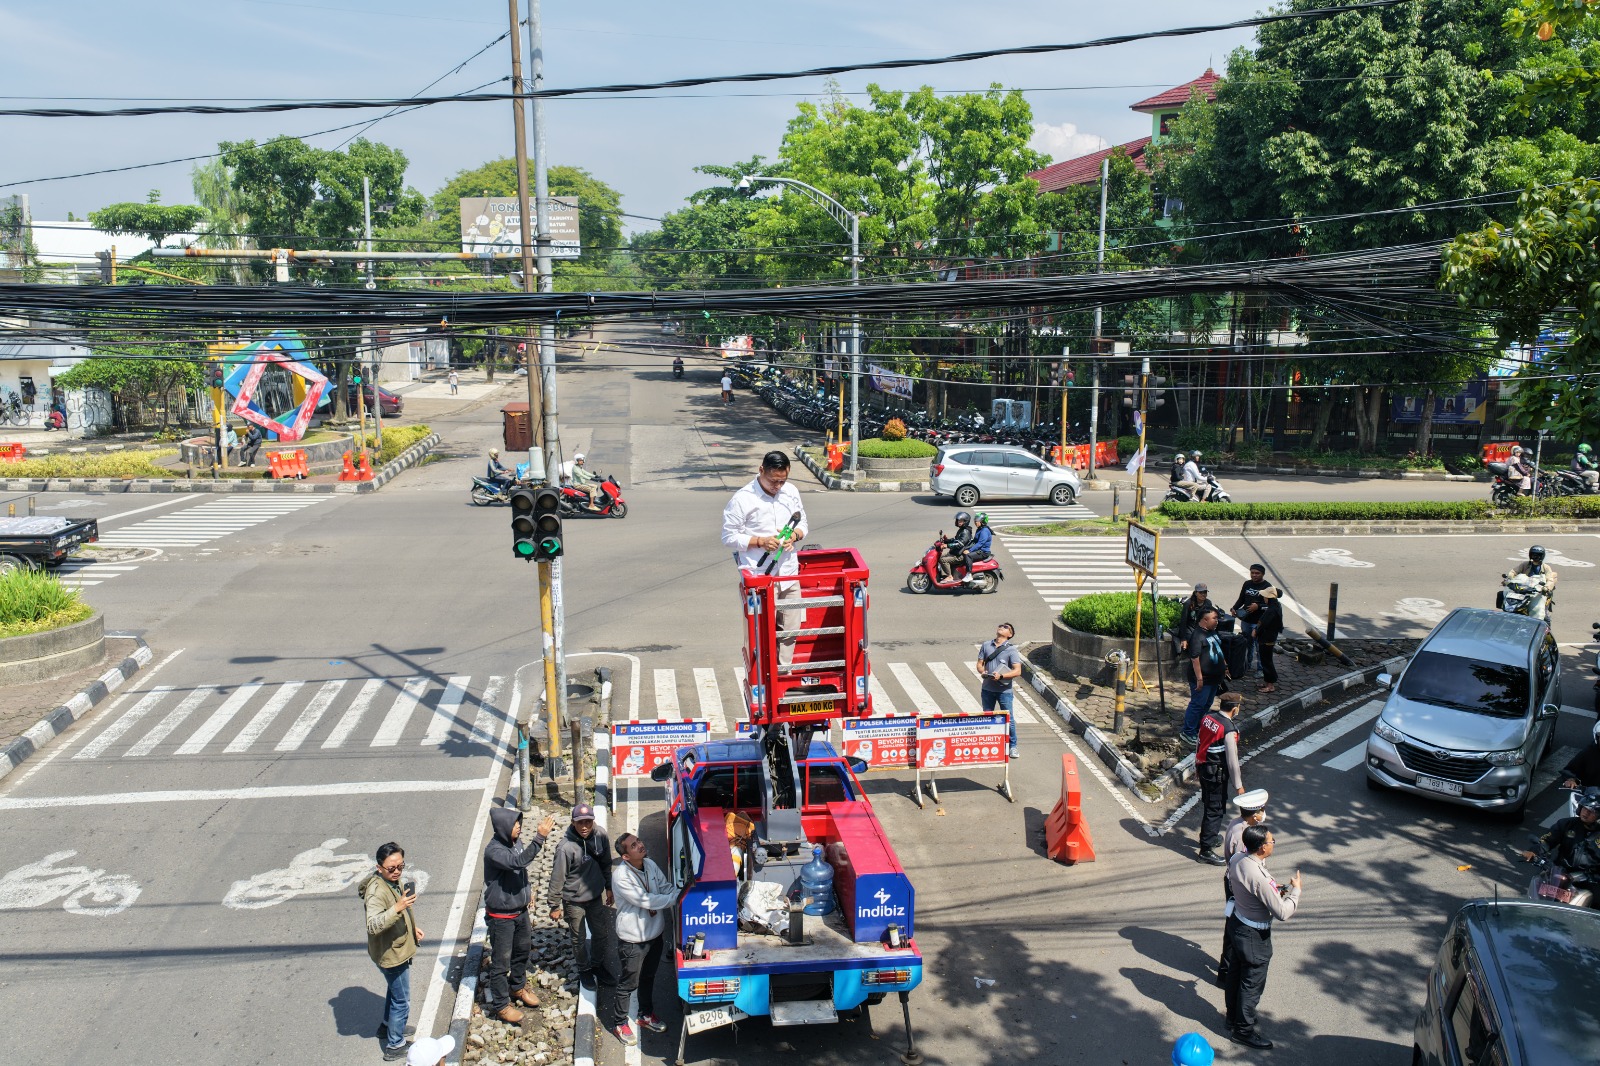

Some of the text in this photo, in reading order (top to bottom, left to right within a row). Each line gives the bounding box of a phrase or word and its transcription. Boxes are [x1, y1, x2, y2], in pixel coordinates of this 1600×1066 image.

[791, 701, 832, 713] MAX. 100 KG
[657, 724, 693, 732] LENGKONG
[933, 718, 957, 726] POLSEK
[1202, 716, 1220, 734] POLISI
[878, 738, 904, 746] BEYOND
[951, 736, 978, 744] BEYOND
[858, 904, 905, 918] indibiz
[685, 912, 734, 926] indibiz
[699, 1009, 724, 1024] 8298
